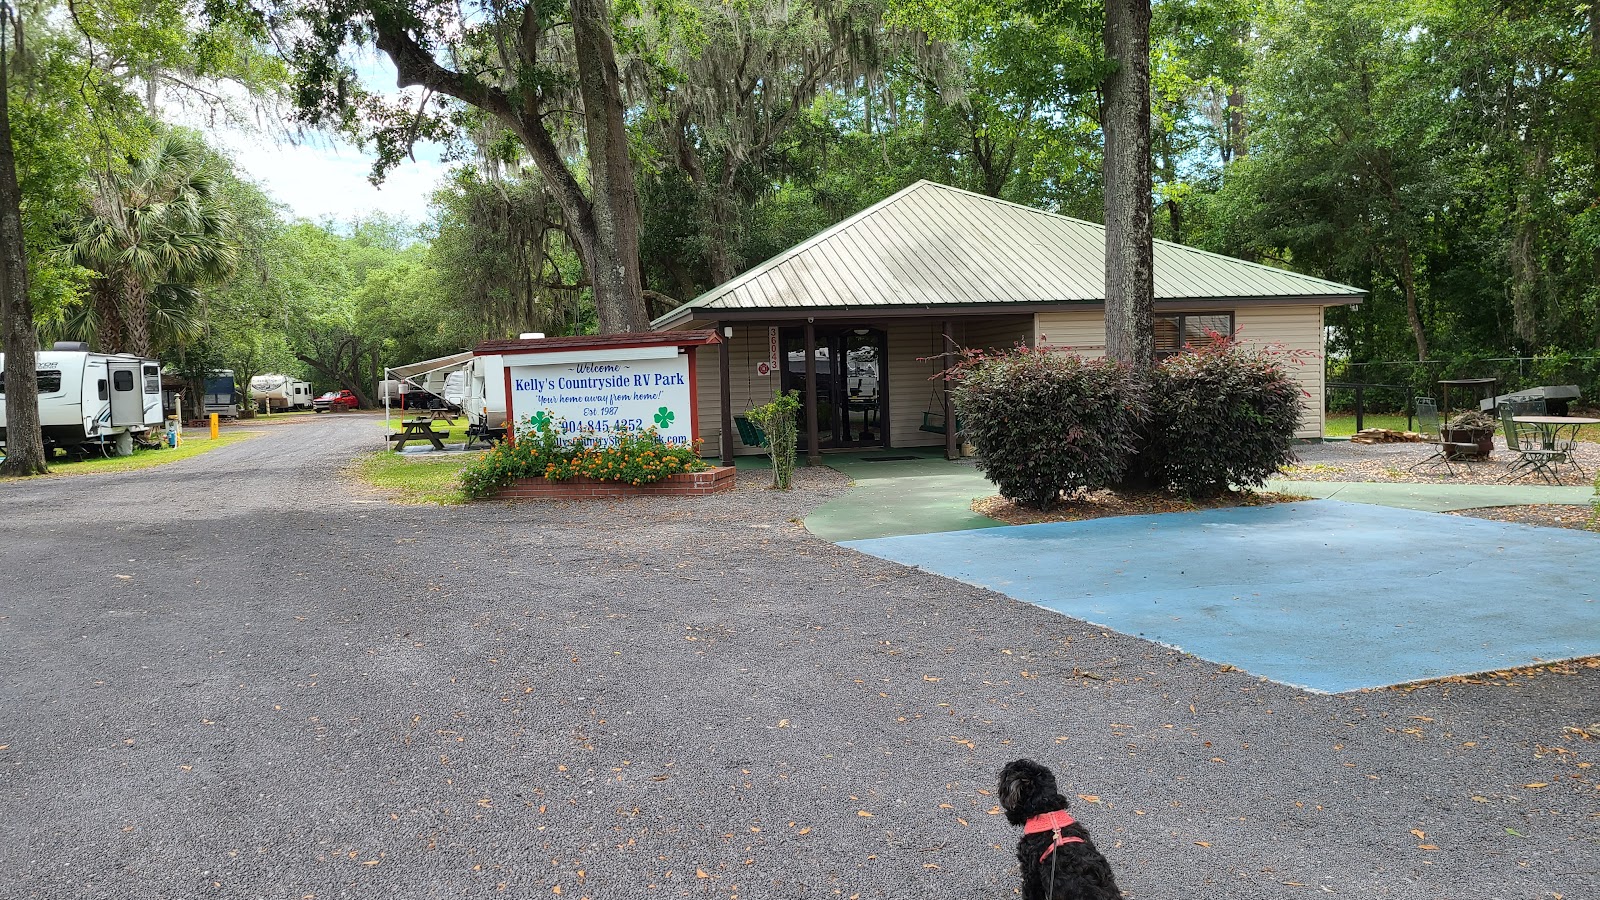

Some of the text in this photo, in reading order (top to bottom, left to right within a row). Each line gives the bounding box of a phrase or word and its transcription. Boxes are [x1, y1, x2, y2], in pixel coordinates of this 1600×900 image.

[576, 362, 620, 374] Welcome
[515, 373, 685, 392] Kelly's Countryside RV Park
[560, 394, 583, 403] home
[584, 394, 608, 405] away
[609, 391, 631, 405] from
[601, 406, 619, 416] 1987
